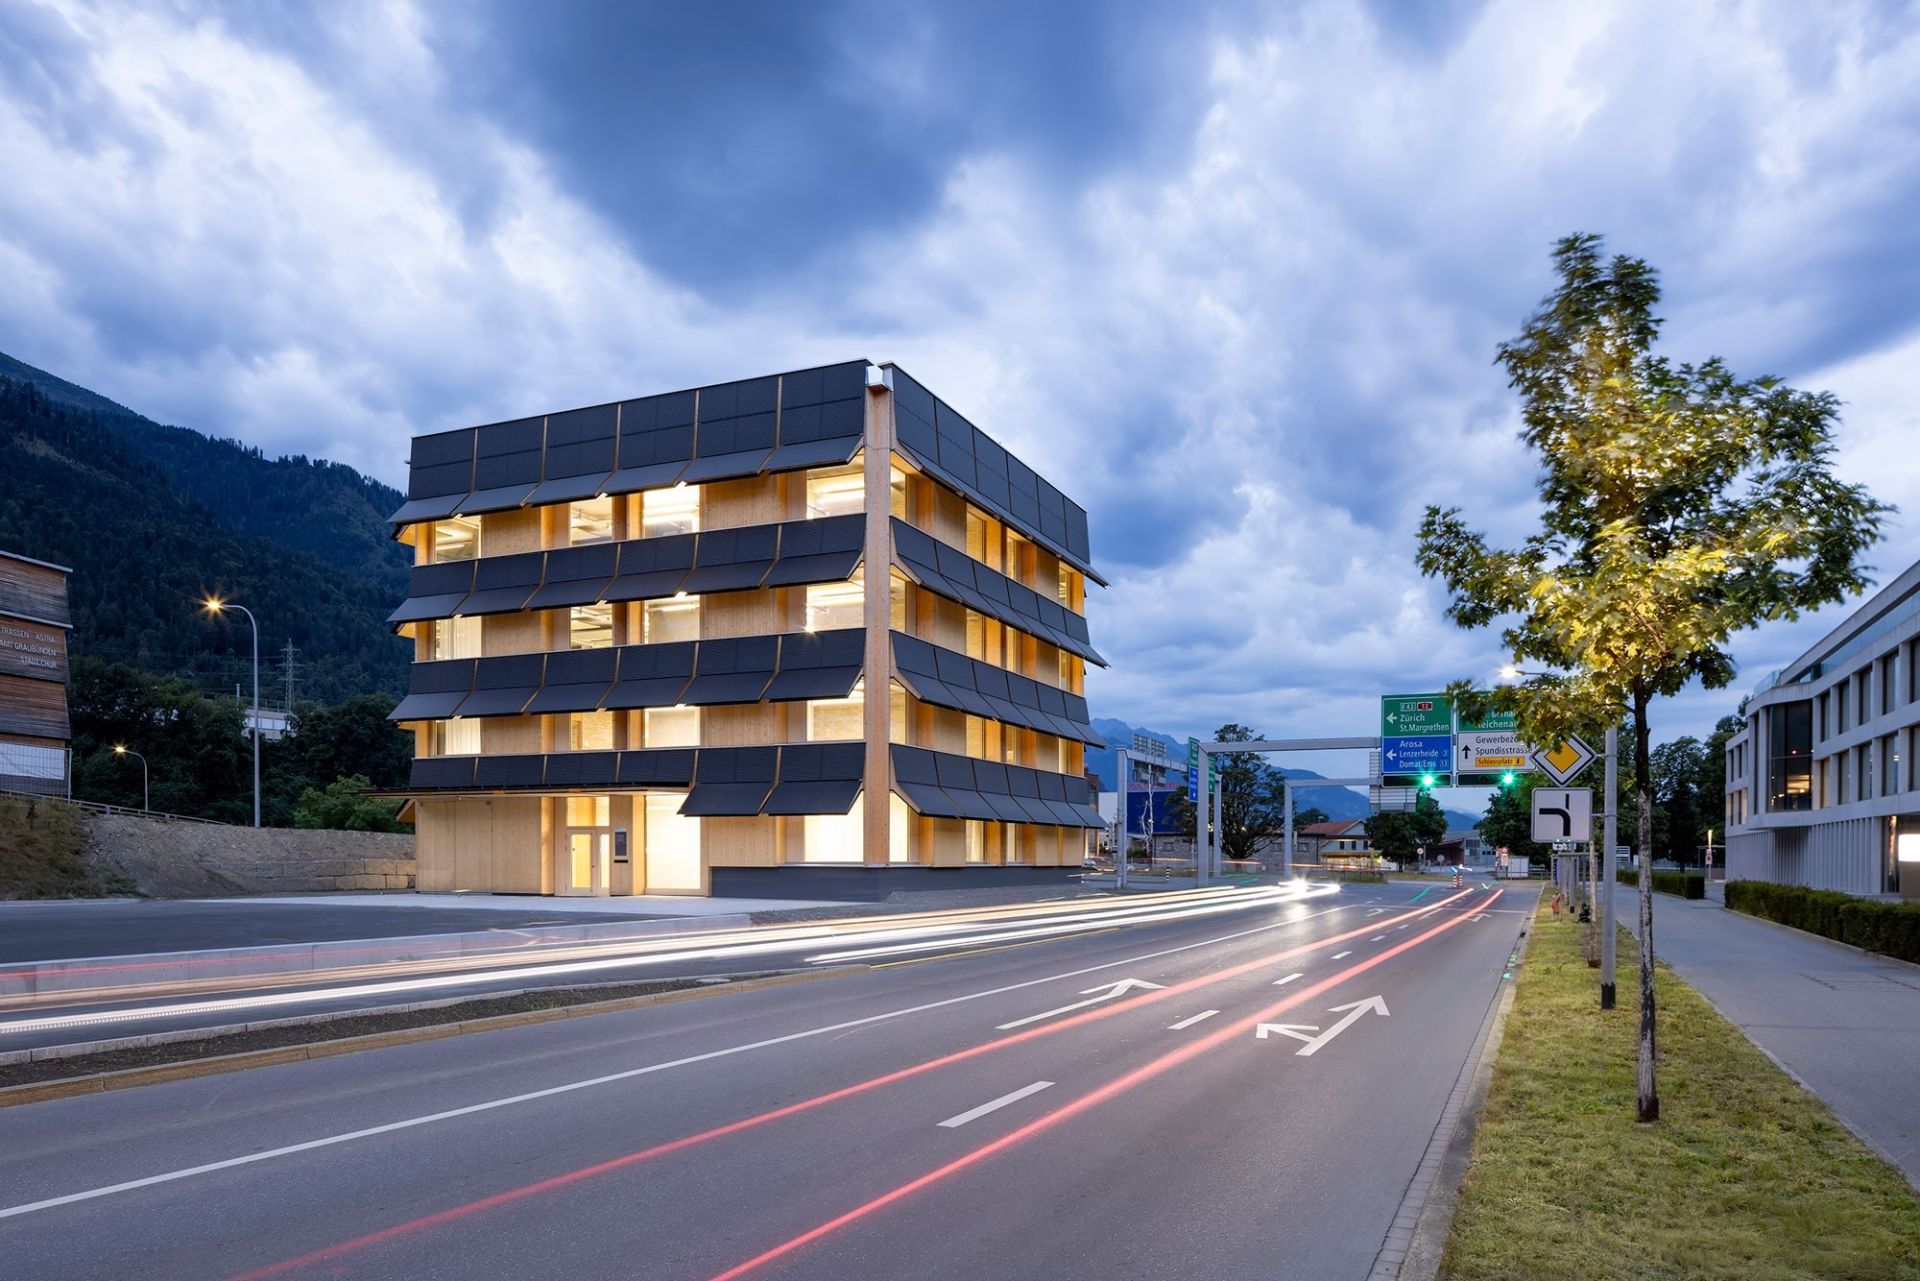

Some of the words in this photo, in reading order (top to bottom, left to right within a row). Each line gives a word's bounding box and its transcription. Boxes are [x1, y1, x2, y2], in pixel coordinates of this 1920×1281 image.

[1400, 713, 1425, 722] Zürich
[1399, 740, 1423, 748] Arosa
[1475, 735, 1520, 744] Gewerbezo
[1399, 749, 1439, 758] Lenzerheide
[1475, 746, 1532, 756] Spundisstrasse
[1399, 760, 1436, 768] Domat/Ems
